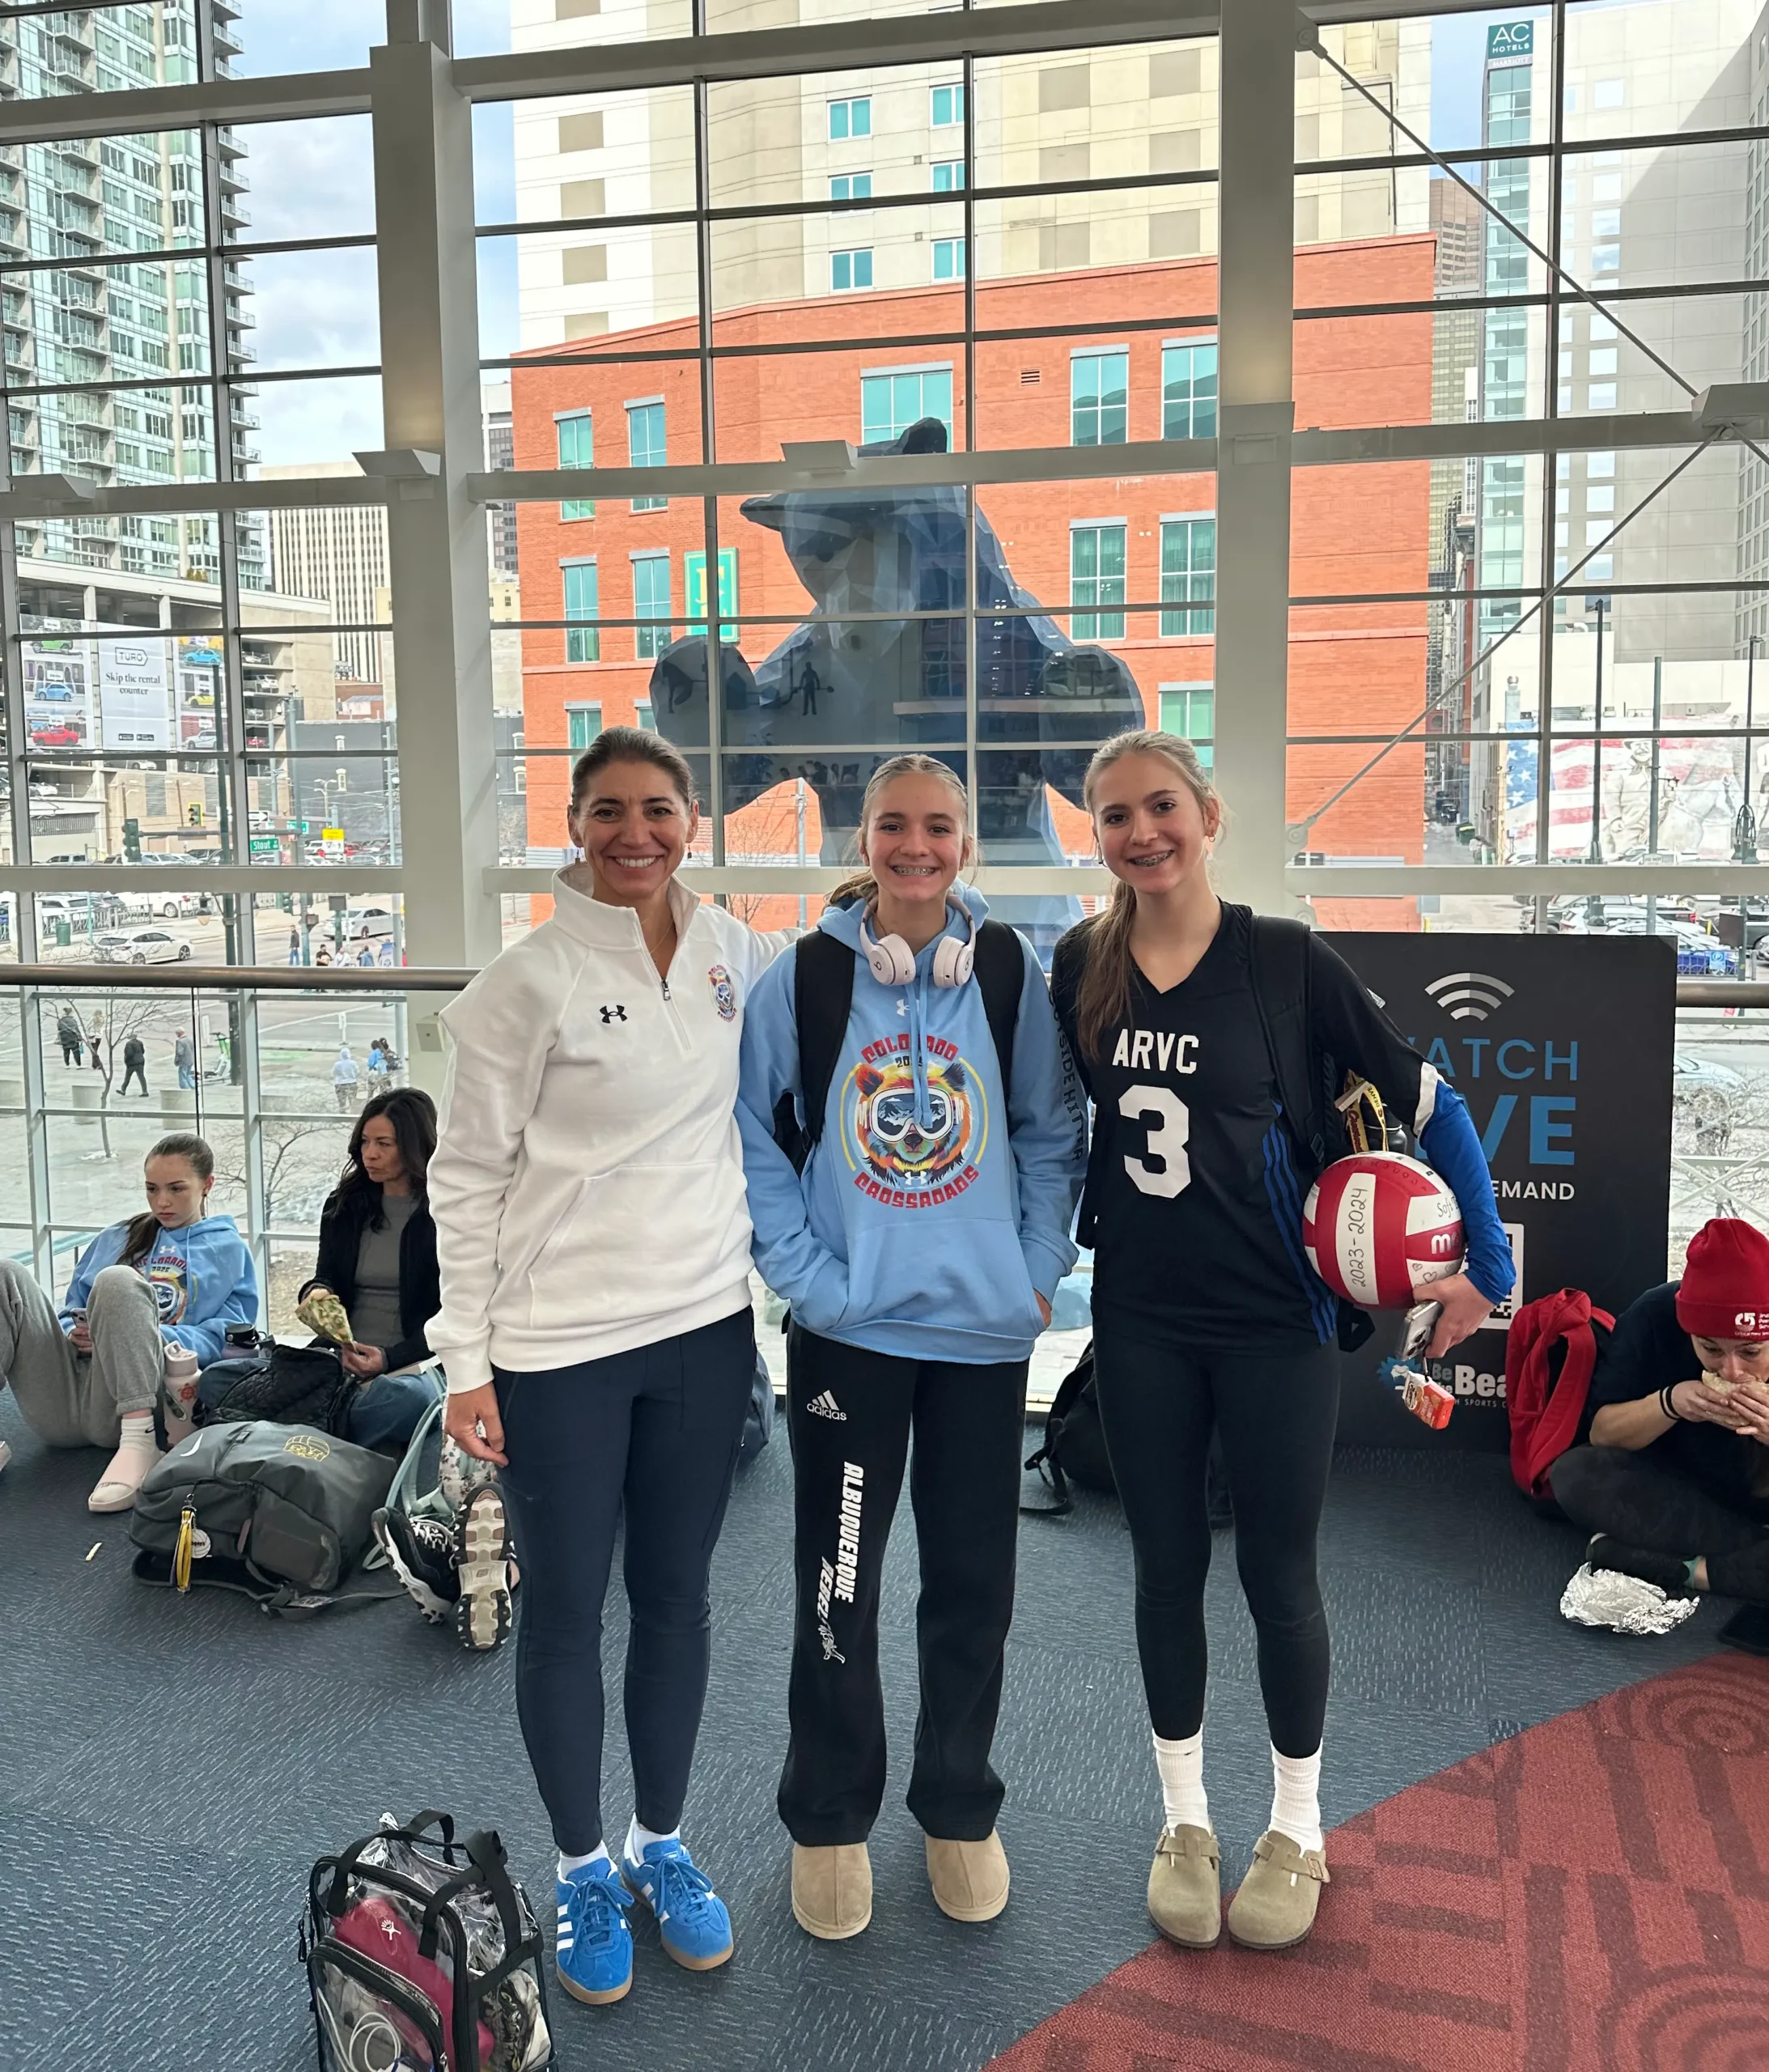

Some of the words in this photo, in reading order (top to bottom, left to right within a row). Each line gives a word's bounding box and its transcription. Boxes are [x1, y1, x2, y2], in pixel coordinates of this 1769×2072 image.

[1492, 23, 1529, 45] AC
[1492, 43, 1529, 53] HOTELS
[119, 652, 143, 662] TURO
[105, 672, 124, 685] Skip
[125, 673, 138, 683] the
[138, 675, 161, 684] rental
[119, 687, 149, 695] counter
[253, 839, 271, 851] Stout
[860, 1033, 959, 1064] COLOADO
[1112, 1028, 1199, 1074] ARVC
[1407, 1036, 1578, 1081] ATCH
[1063, 1089, 1085, 1161] HITTER
[1415, 1093, 1576, 1166] VE
[1118, 1085, 1191, 1199] 3
[853, 1164, 980, 1209] CROSSROADS
[1491, 1179, 1576, 1201] EMAND
[1436, 1197, 1453, 1218] Soft
[1432, 1362, 1453, 1381] Be
[1454, 1364, 1507, 1399] Bea
[807, 1402, 847, 1421] adidas
[1464, 1398, 1497, 1408] SPORTS
[834, 1461, 864, 1603] ALBUQUERQUE
[817, 1556, 835, 1621] REBEL
